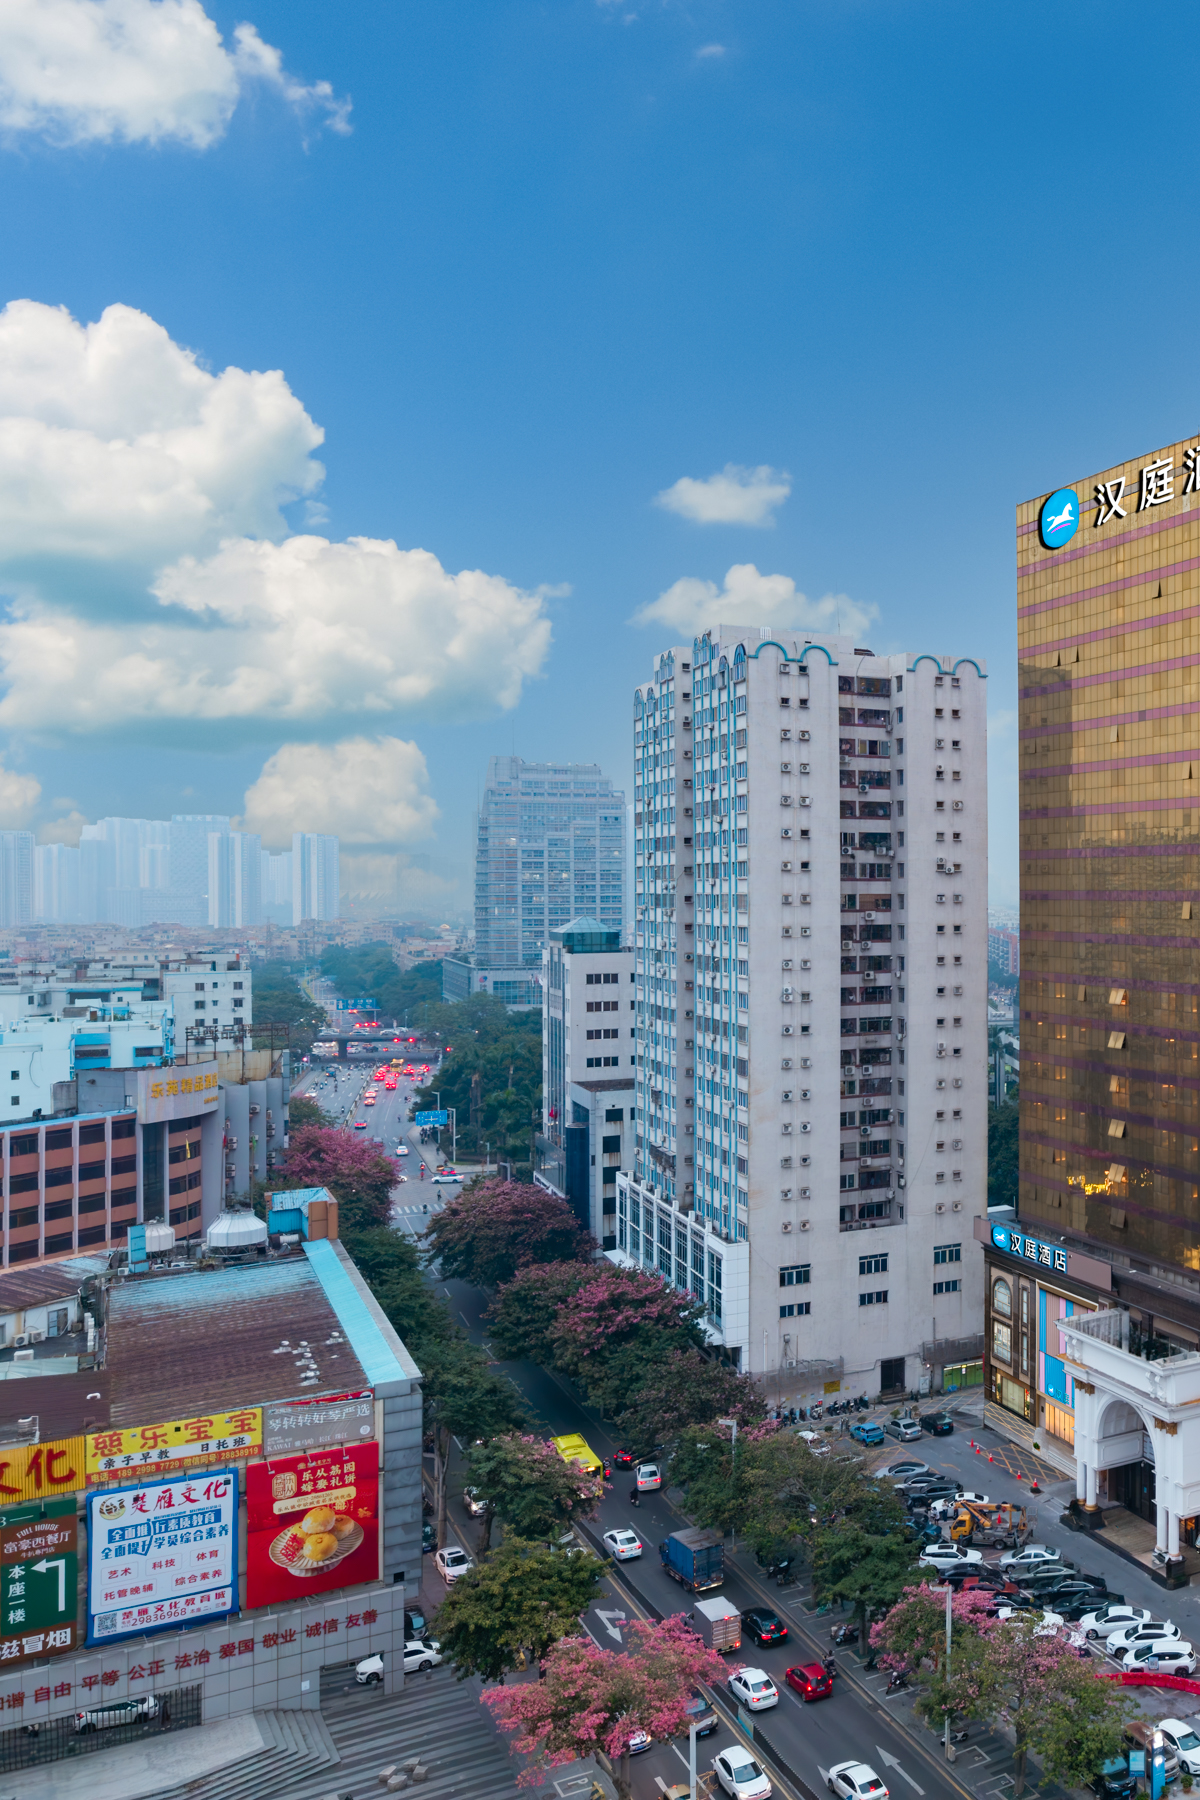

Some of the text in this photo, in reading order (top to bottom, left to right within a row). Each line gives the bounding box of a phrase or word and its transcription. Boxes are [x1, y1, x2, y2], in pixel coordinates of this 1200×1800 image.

[1011, 1233, 1066, 1272] 汉庭酒店
[91, 1410, 258, 1458] 慈乐宝宝
[104, 1448, 170, 1470] 亲子早教
[201, 1436, 246, 1453] 日托班
[267, 1443, 292, 1452] KAWAI
[117, 1469, 132, 1477] 189
[136, 1464, 156, 1475] 2998
[302, 1461, 356, 1482] 乐从荔园
[300, 1473, 357, 1493] 嫁娶礼饼
[16, 1523, 60, 1539] FULL HOUSE
[4, 1530, 72, 1554] 富豪西餐厅
[152, 1558, 176, 1571] 科技
[196, 1549, 219, 1562] 体育
[108, 1567, 132, 1580] 艺术
[174, 1569, 223, 1587] 综合素养
[7, 1564, 26, 1625] 本座一楼
[104, 1583, 154, 1602] 托管晚辅
[131, 1607, 187, 1627] 29836968
[34, 1681, 72, 1704] 自由
[82, 1669, 120, 1691] 平等
[129, 1659, 165, 1681] 公正
[174, 1648, 211, 1671] 法治
[219, 1637, 255, 1660] 爱国
[262, 1628, 297, 1649] 敬业
[305, 1617, 339, 1638] 诚信
[345, 1608, 379, 1629] 友善
